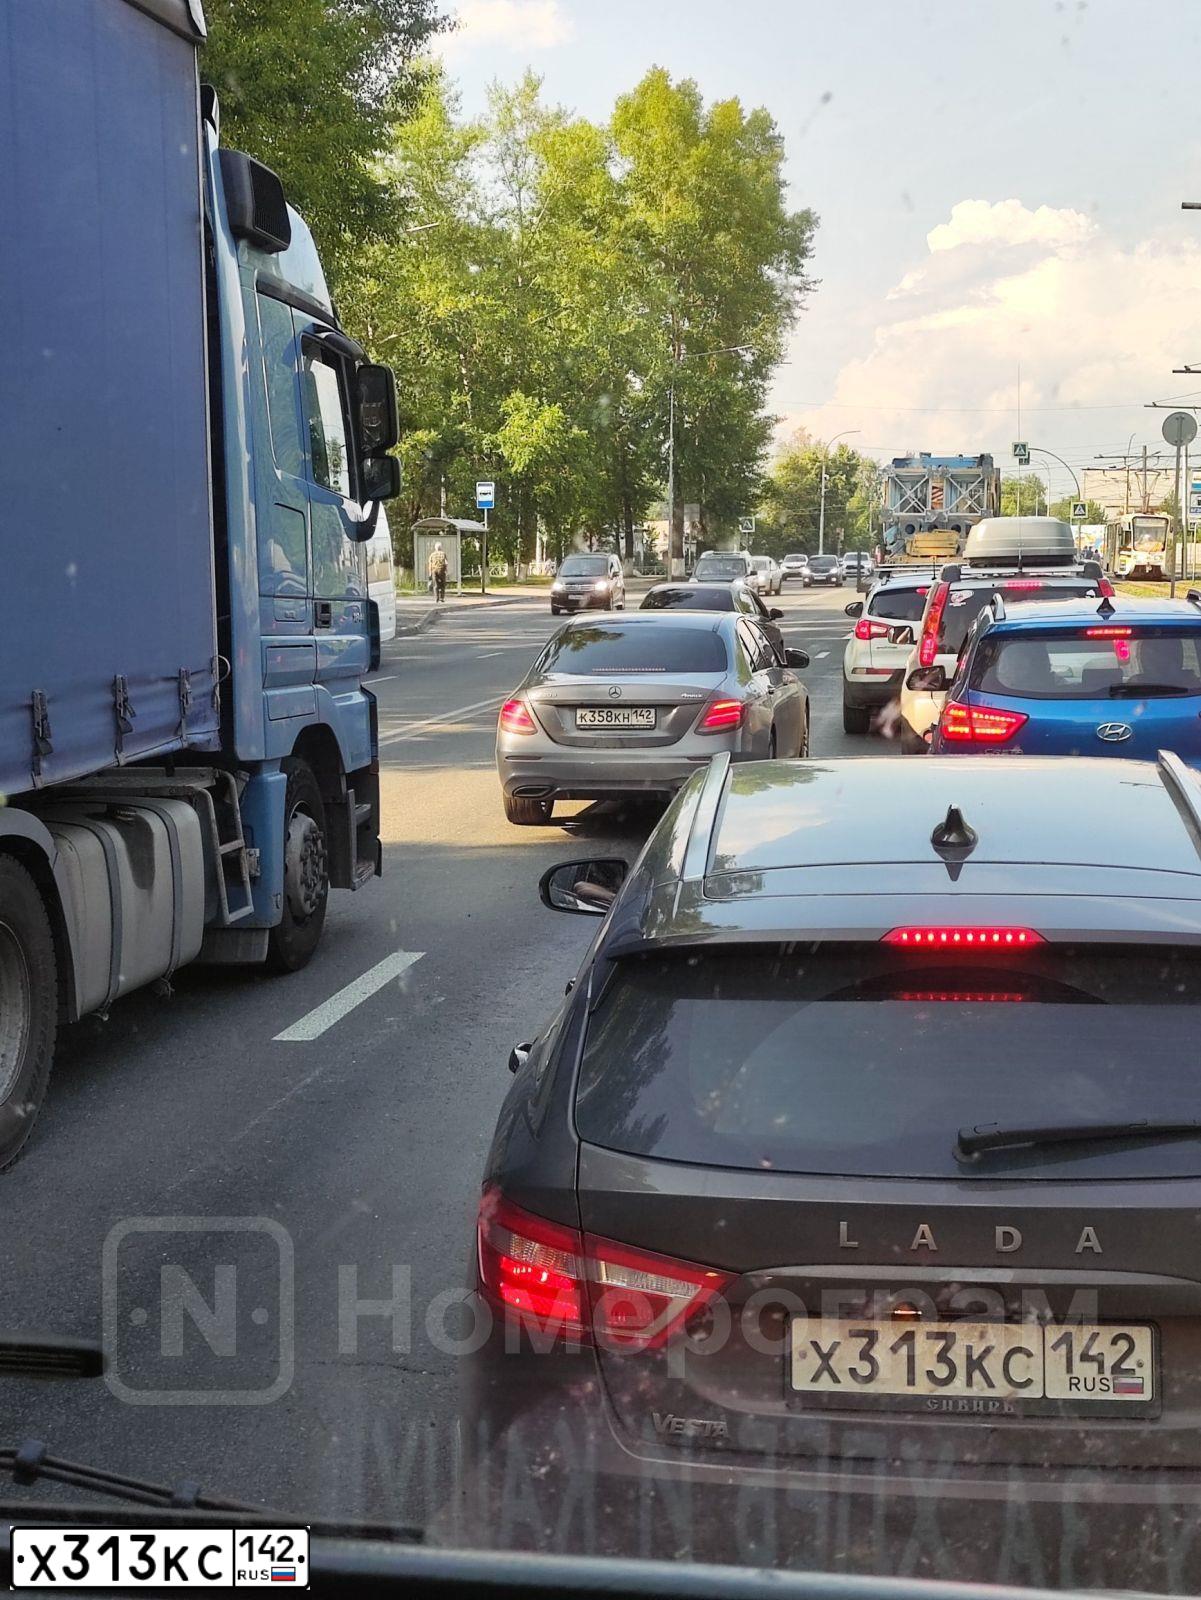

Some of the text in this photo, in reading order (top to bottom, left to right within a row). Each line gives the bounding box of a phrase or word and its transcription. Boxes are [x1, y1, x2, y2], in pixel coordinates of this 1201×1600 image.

[580, 709, 652, 723] К358КН 142
[839, 1221, 1103, 1253] LADA
[809, 1329, 1137, 1389] Х313КС 142
[1068, 1376, 1111, 1393] RUS
